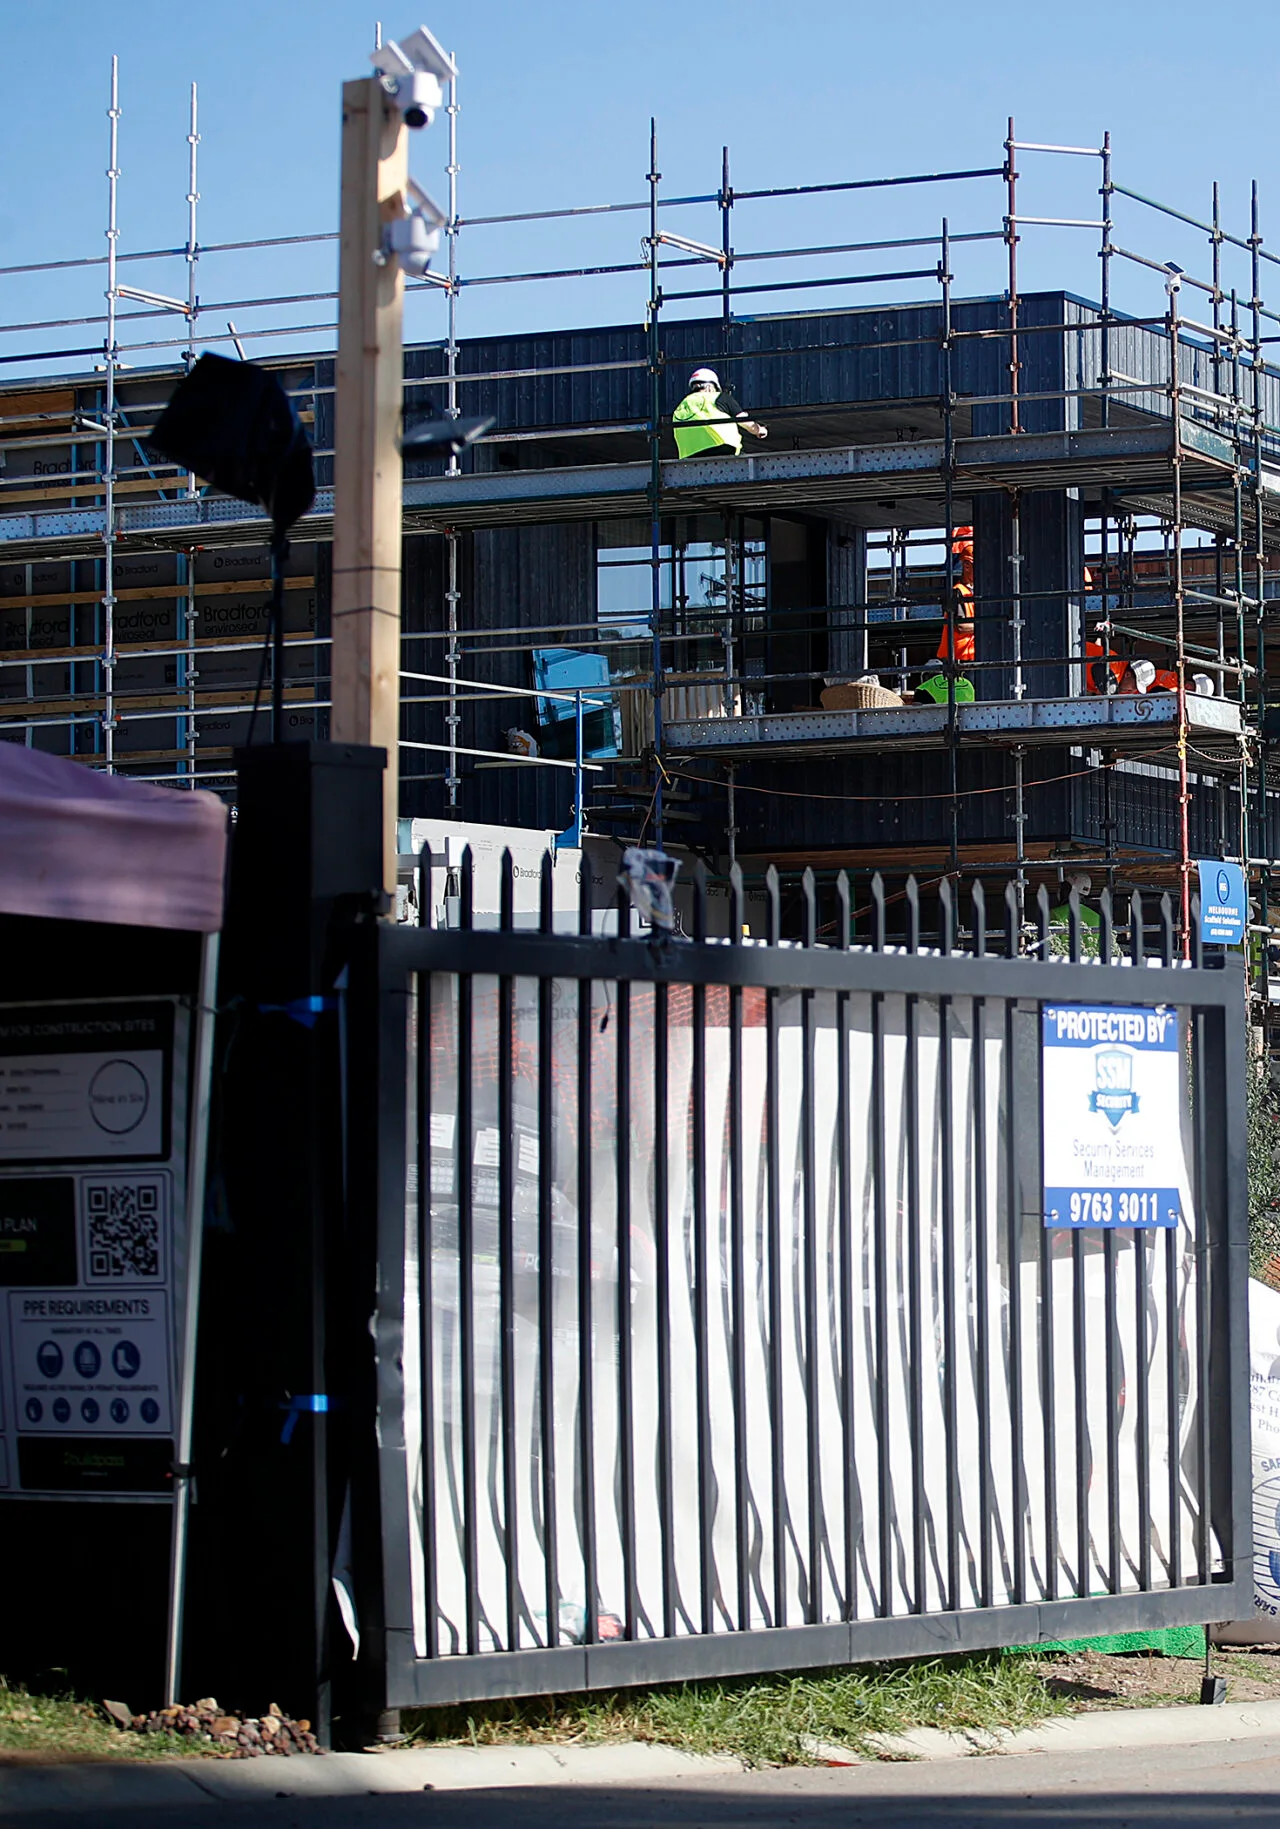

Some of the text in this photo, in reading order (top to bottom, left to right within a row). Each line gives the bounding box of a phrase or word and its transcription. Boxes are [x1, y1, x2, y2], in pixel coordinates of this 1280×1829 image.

[113, 609, 170, 629] radford
[1057, 1010, 1166, 1043] PROTECTED BY
[1073, 1138, 1155, 1160] Security Services
[1083, 1160, 1145, 1183] Management
[1070, 1192, 1158, 1222] 9763 3011
[24, 1299, 150, 1315] PPE REQUIREMENTS
[1250, 1402, 1265, 1414] est
[1254, 1594, 1279, 1616] SAR
